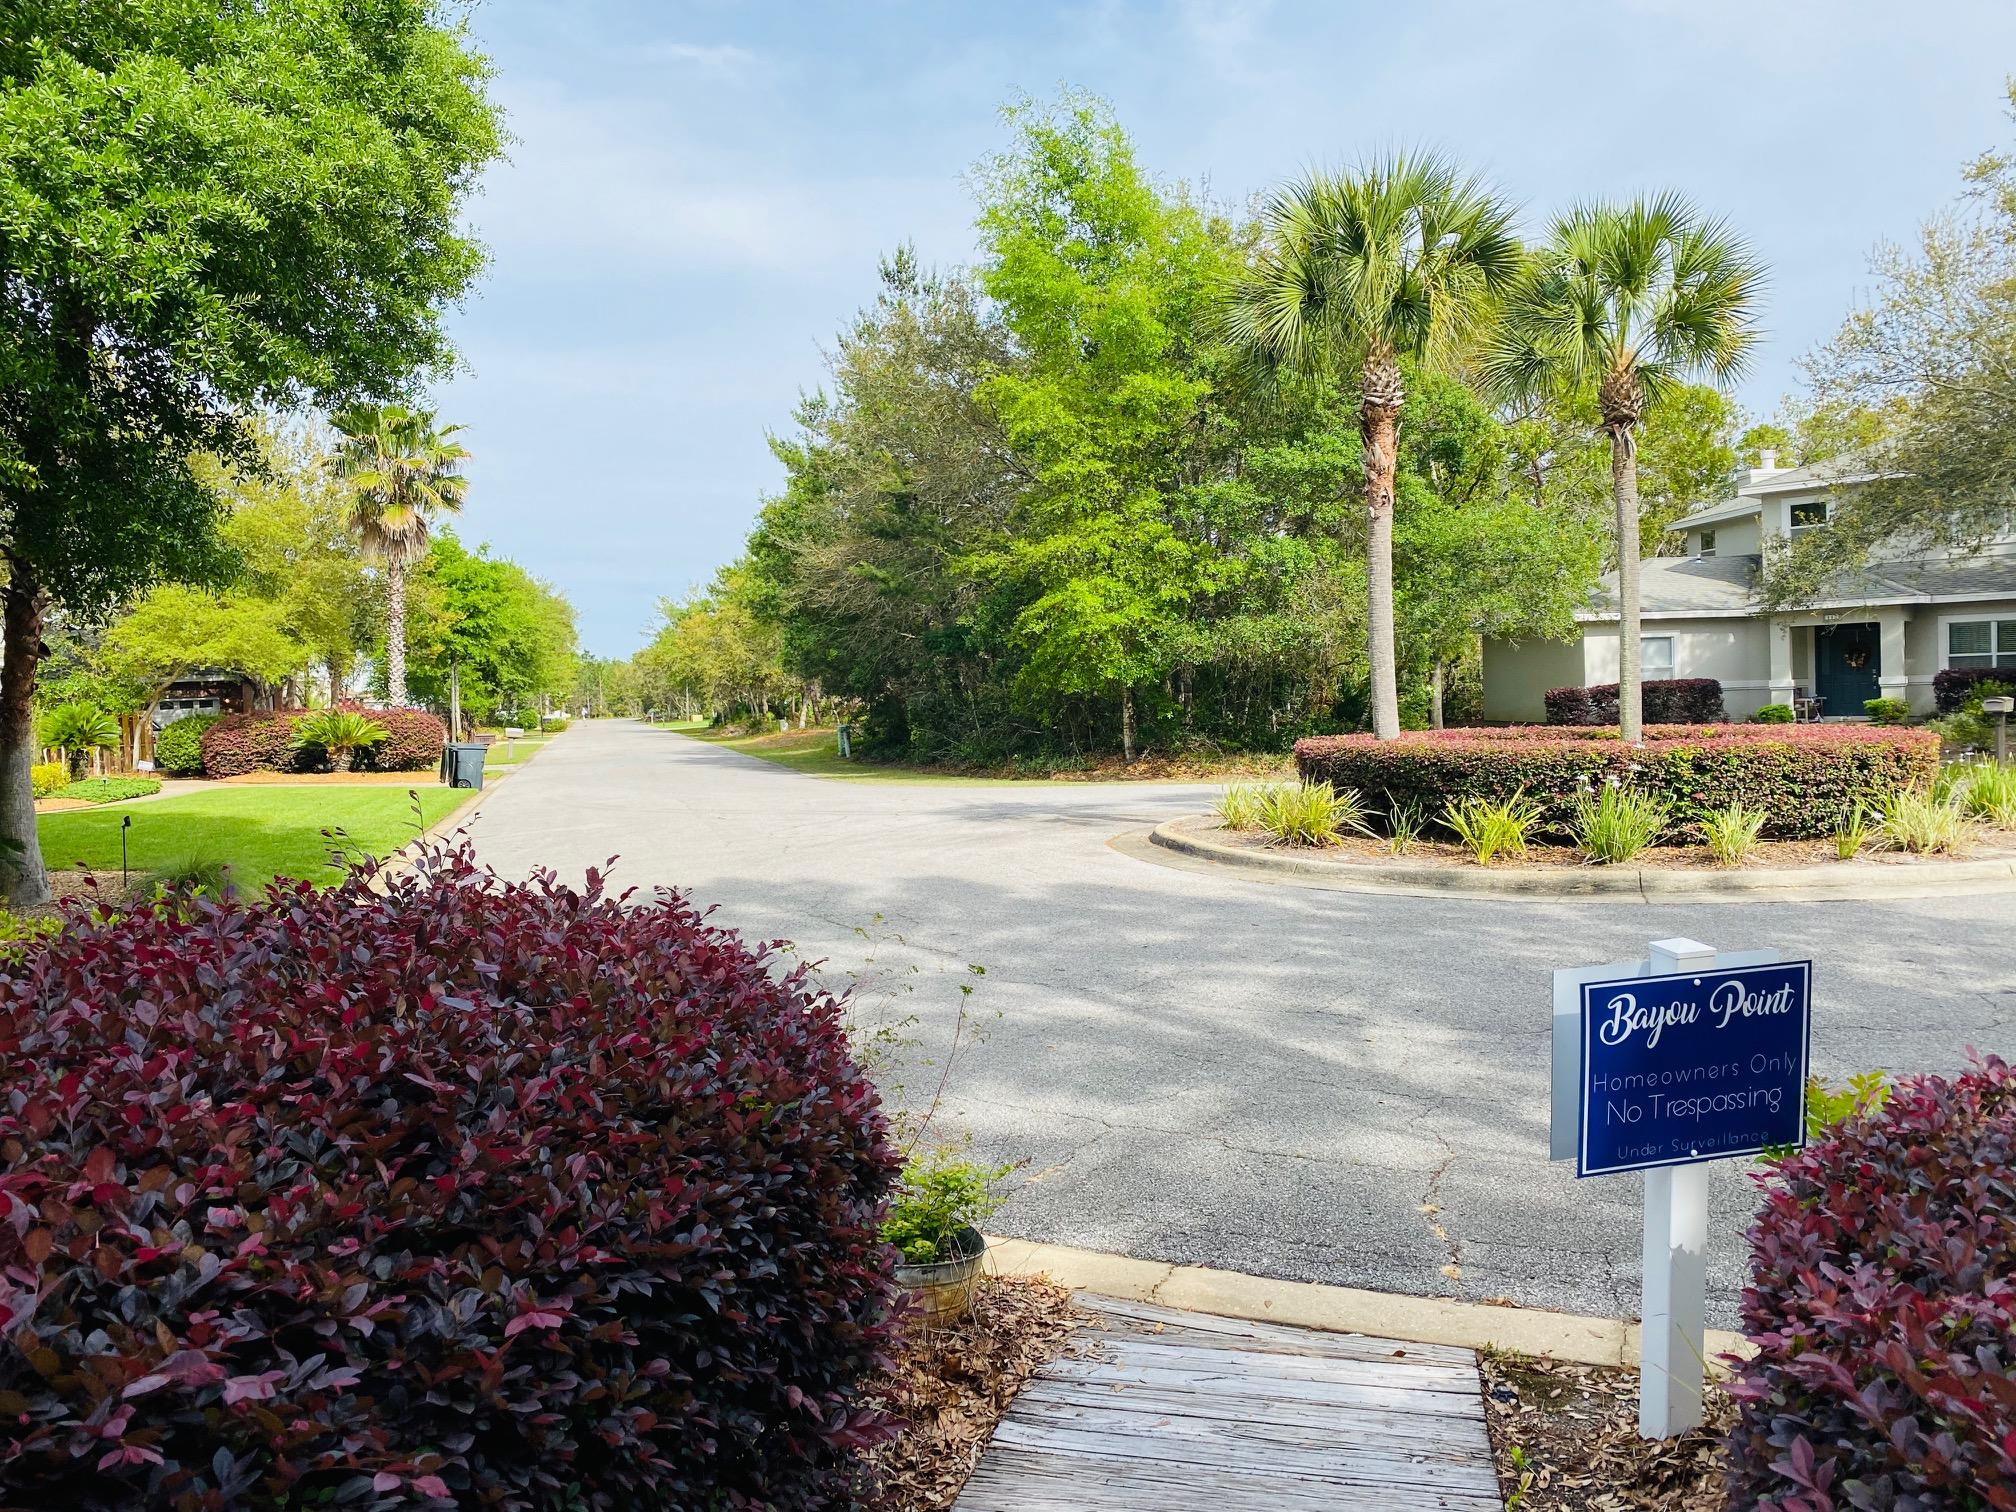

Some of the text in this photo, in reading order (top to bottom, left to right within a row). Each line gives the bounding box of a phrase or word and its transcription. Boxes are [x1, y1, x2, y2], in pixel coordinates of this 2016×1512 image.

[1599, 980, 1796, 1049] Bayou Point
[1593, 1051, 1797, 1094] Homeowners Only
[1607, 1086, 1782, 1126] No Trespassing
[1617, 1131, 1769, 1160] Under Surveillance
